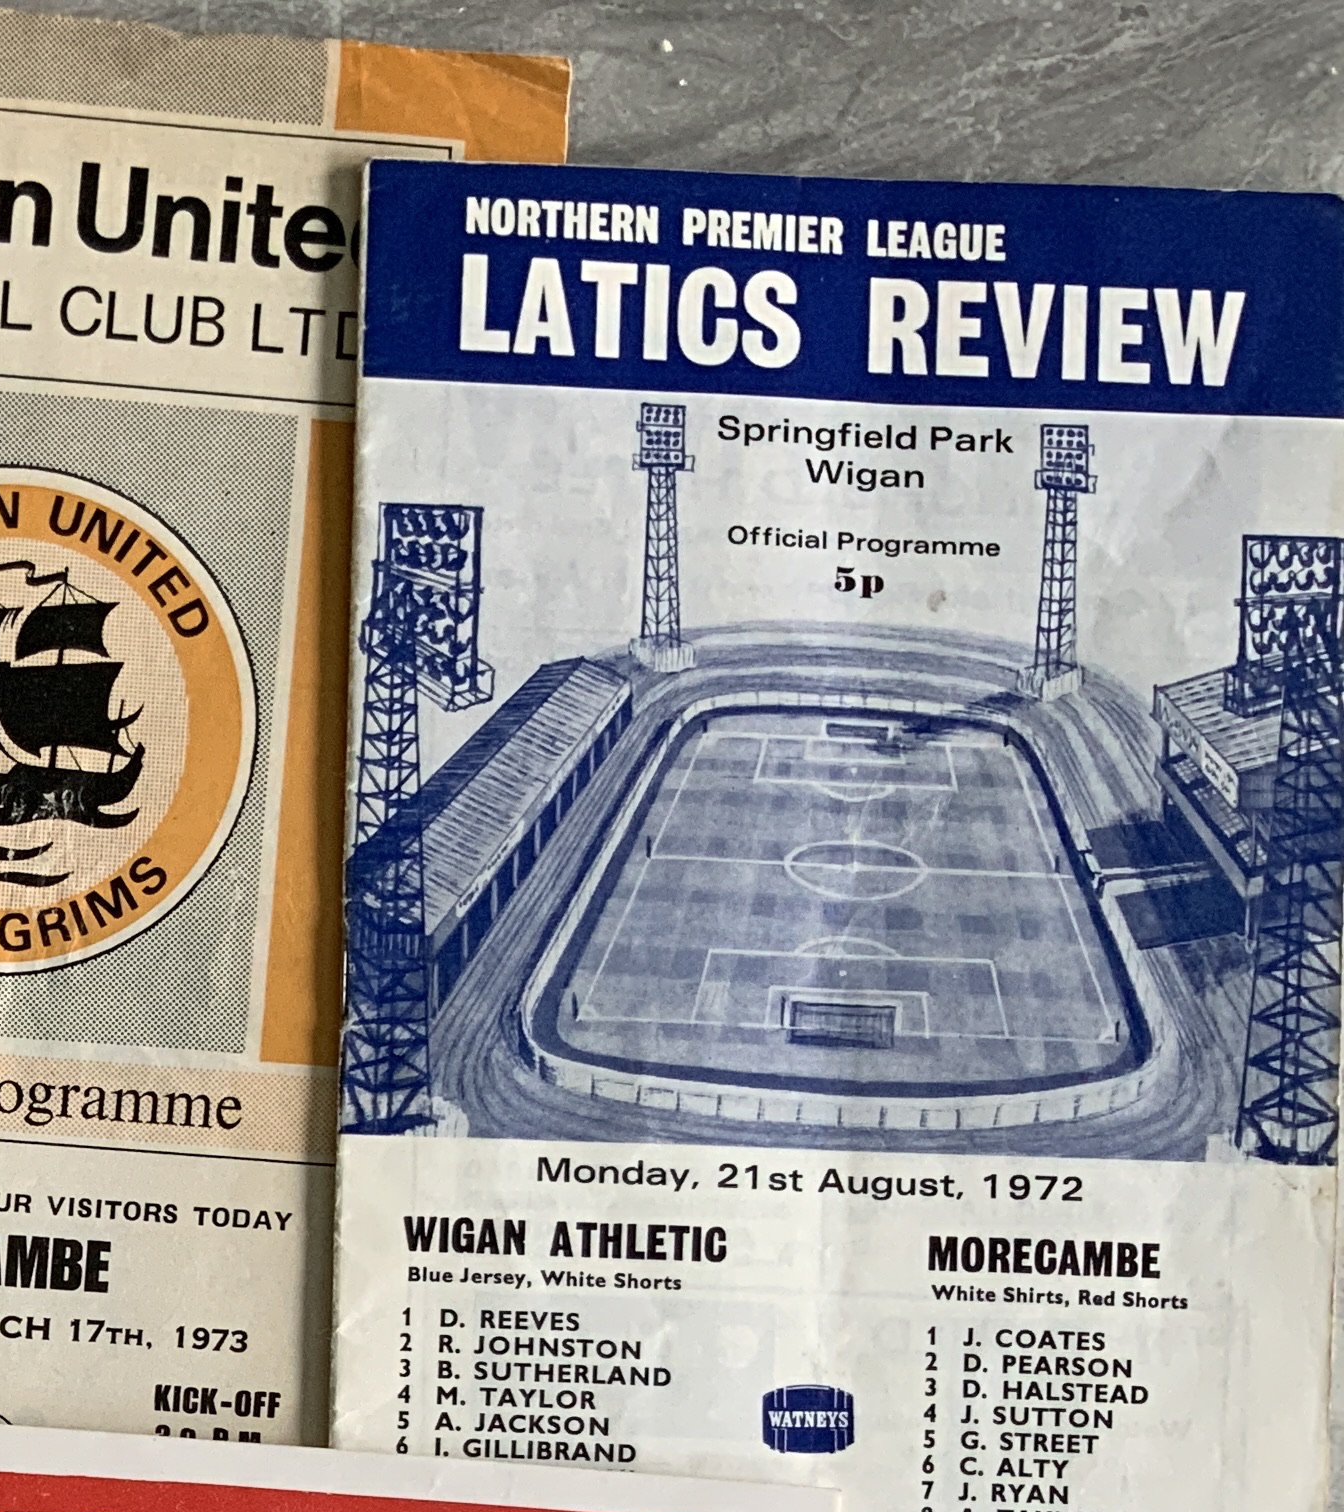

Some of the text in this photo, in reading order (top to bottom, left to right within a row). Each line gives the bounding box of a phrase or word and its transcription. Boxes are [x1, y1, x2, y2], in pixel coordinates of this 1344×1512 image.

[77, 161, 364, 281] Unite
[466, 197, 1005, 261] NORTHERN PREMIER LEAGUE
[60, 286, 224, 347] CLUB
[460, 254, 1245, 386] LATICS REVIEW
[718, 415, 1013, 453] Springfield Park
[806, 459, 924, 492] Wigan
[728, 526, 1000, 557] Official Programme
[43, 490, 215, 643] UNITED
[835, 567, 884, 598] 5p
[538, 1157, 1082, 1201] Monday, 21st August, 1972
[48, 1196, 177, 1223] VISITORS
[194, 1207, 292, 1230] TODAY
[404, 1216, 726, 1262] WIGAN ATHLETIC
[929, 1236, 1160, 1278] MORECAMBE
[408, 1267, 681, 1290] Blue Jersey, White Shorts
[932, 1285, 1188, 1309] White Shirts, Red Shorts
[481, 1310, 579, 1331] REEVES
[176, 1326, 248, 1352] 1973
[996, 1329, 1105, 1351] COATES
[155, 1385, 281, 1418] KICK-OFF
[769, 1411, 848, 1427] WATNEYS
